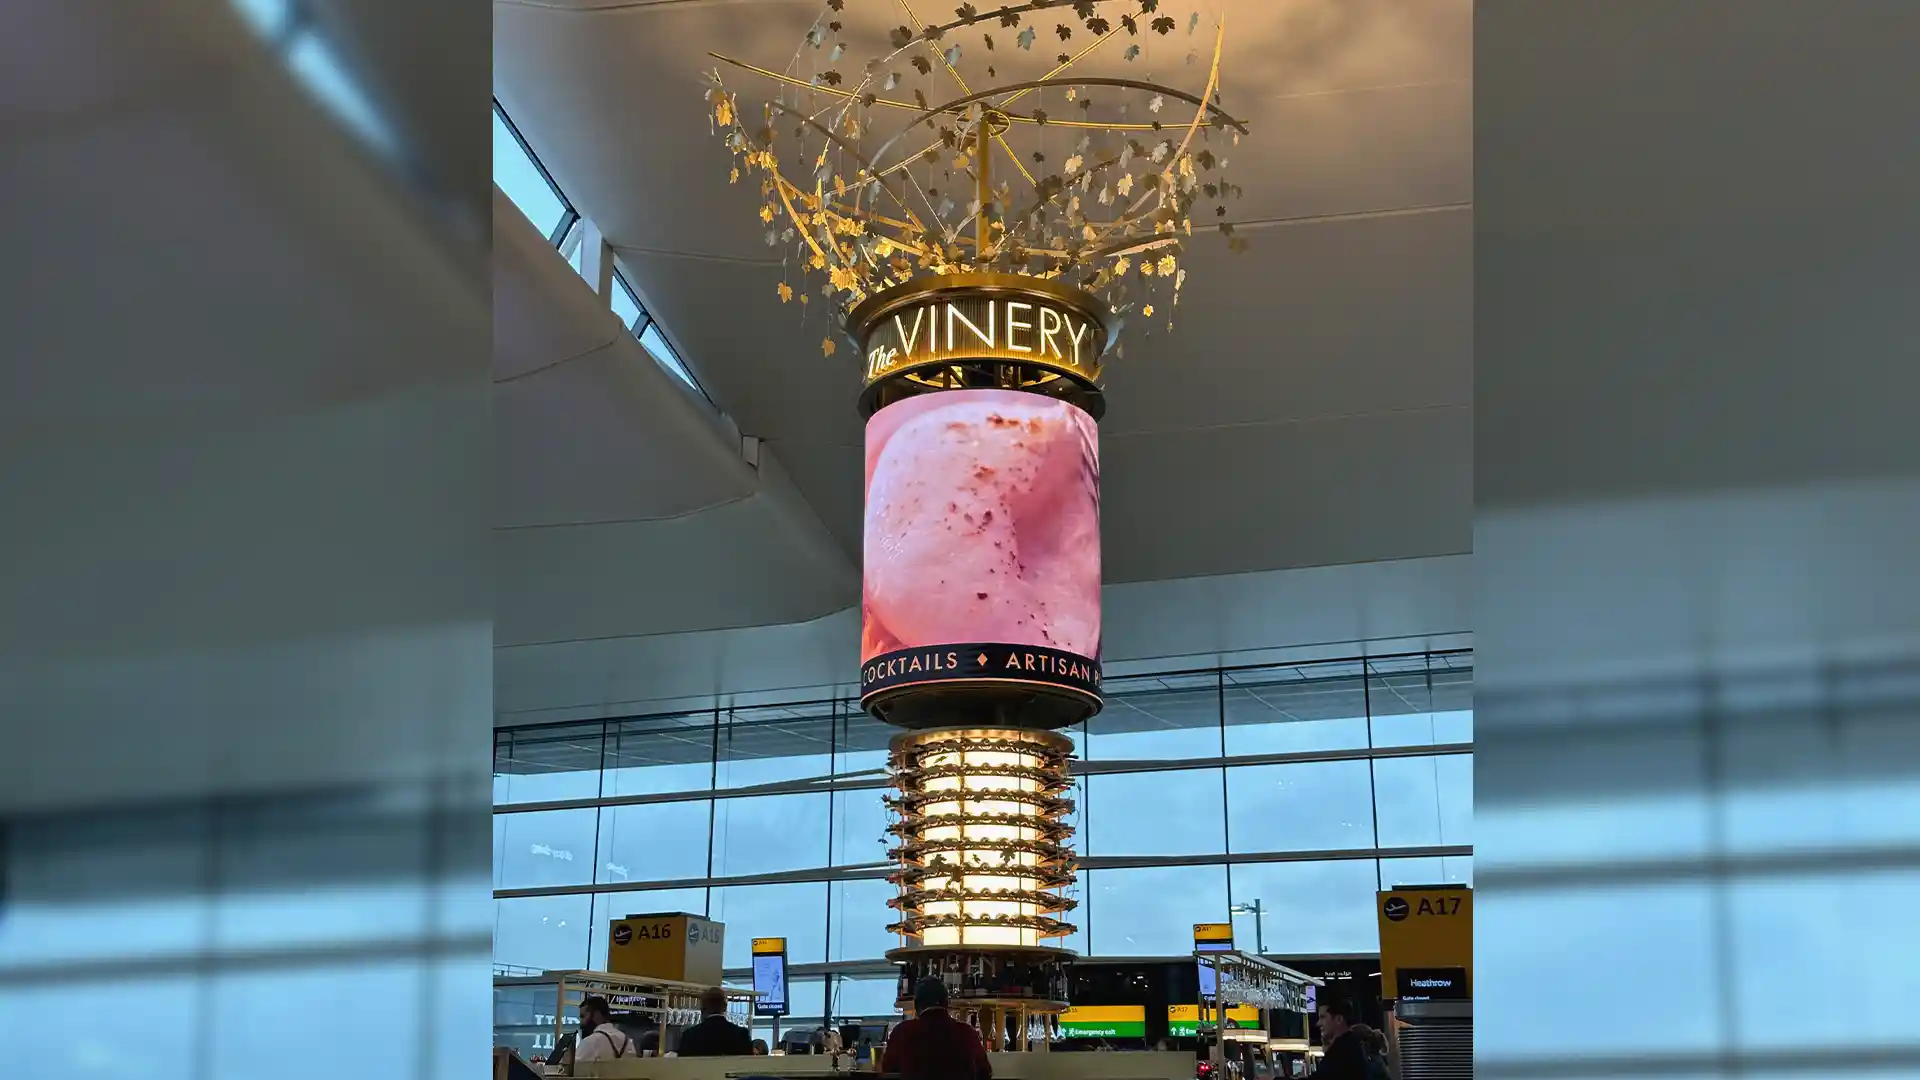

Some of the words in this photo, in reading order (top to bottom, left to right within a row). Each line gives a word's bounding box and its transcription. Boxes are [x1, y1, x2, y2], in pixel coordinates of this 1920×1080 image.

[867, 344, 898, 379] The
[895, 300, 1087, 366] VINERY
[863, 652, 958, 687] COCKTAILS
[1006, 652, 1091, 682] ARTISAN
[1416, 897, 1461, 916] A17
[639, 923, 671, 941] A16
[1410, 978, 1452, 987] Heathrow
